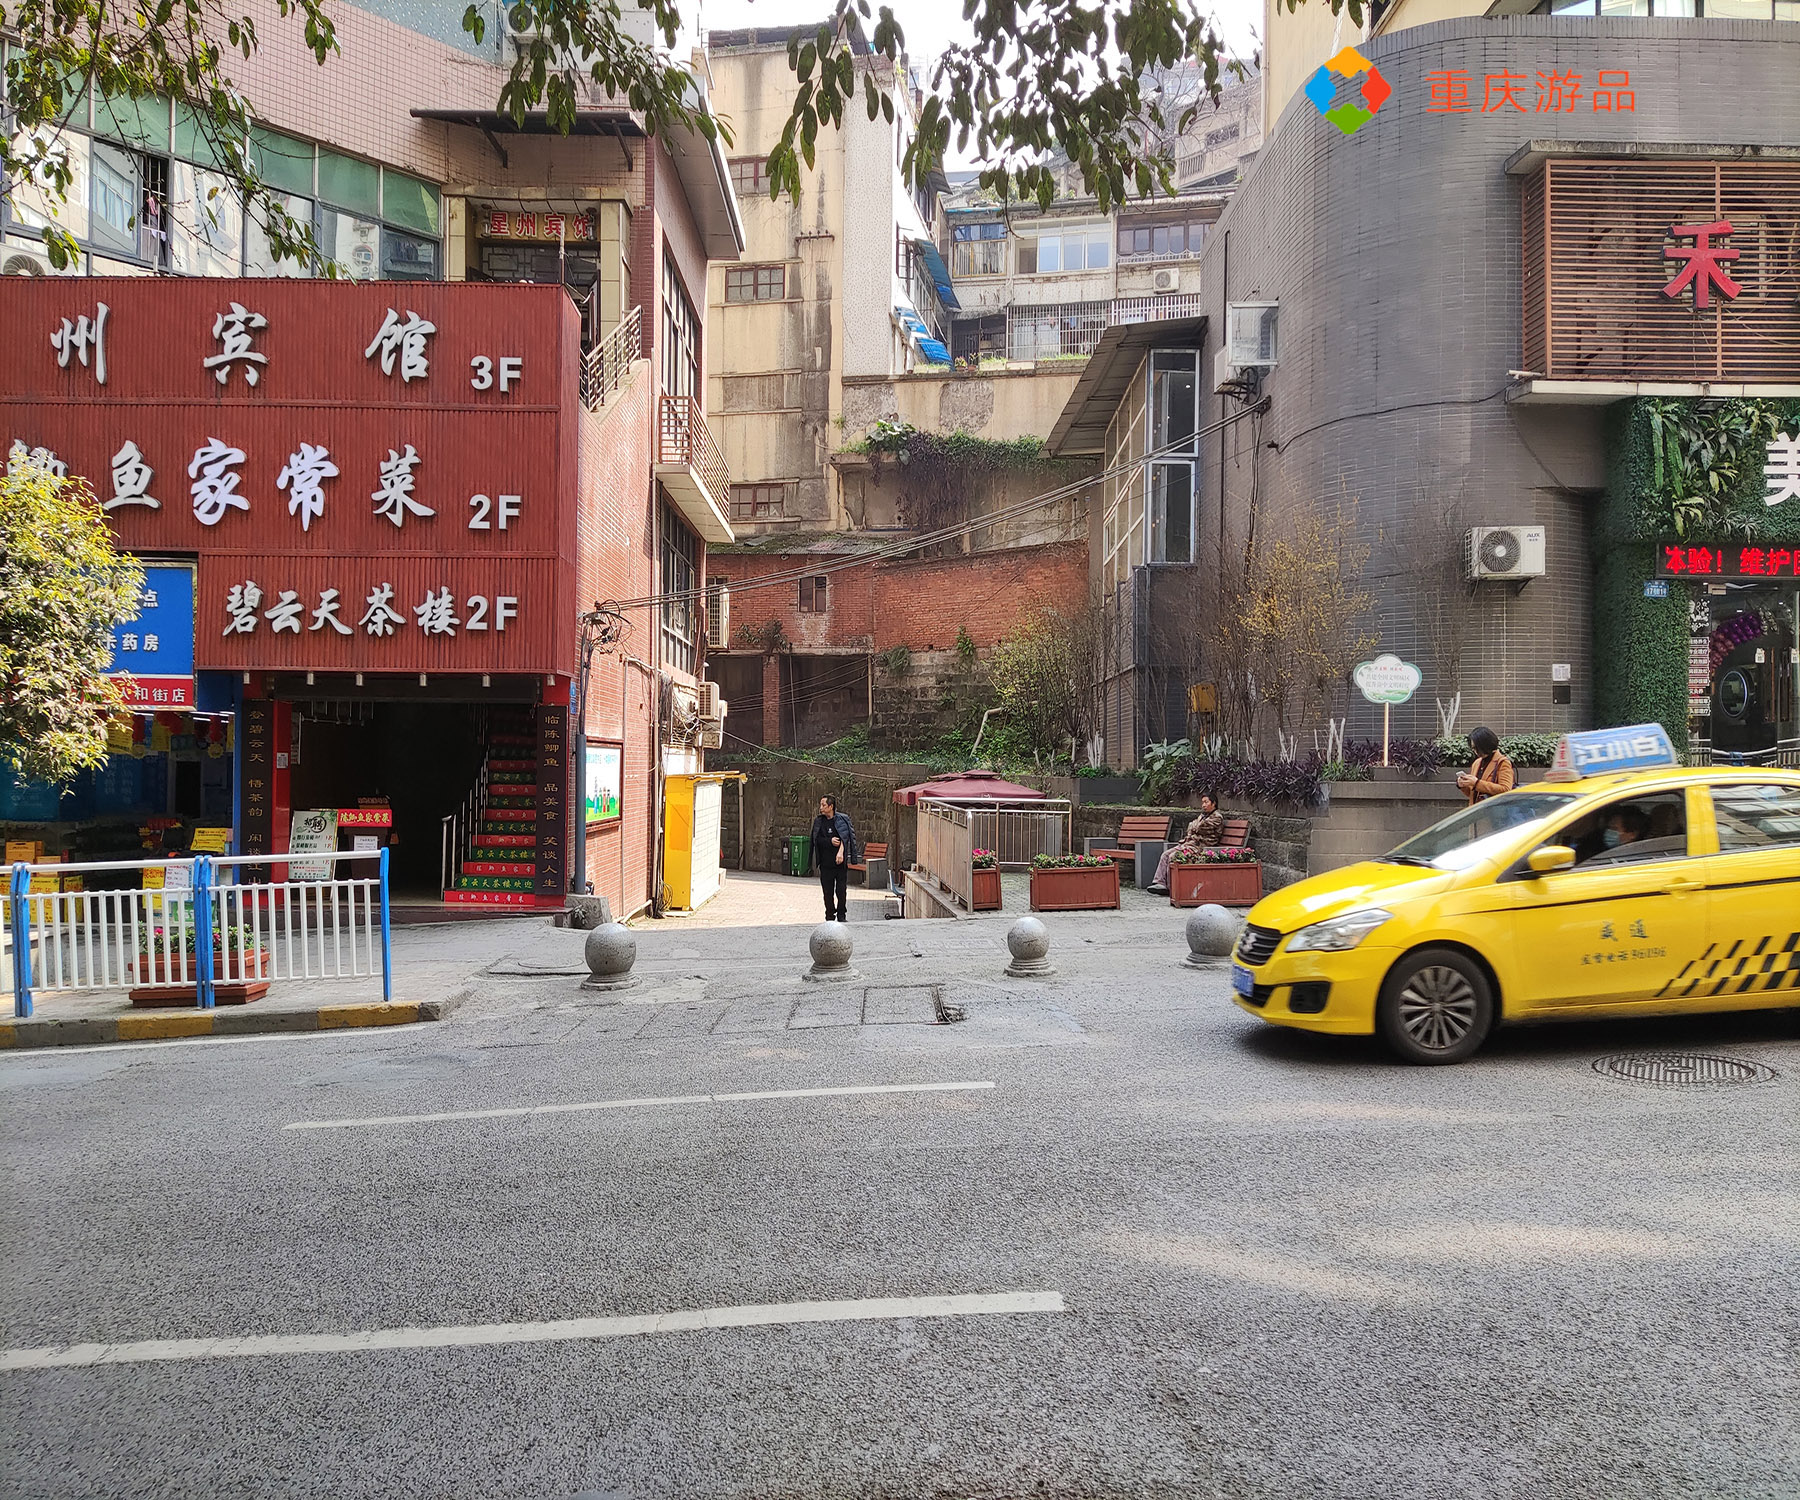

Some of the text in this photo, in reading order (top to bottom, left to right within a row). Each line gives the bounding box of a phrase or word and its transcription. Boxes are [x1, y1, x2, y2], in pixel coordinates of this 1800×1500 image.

[490, 211, 590, 239] 星州宾馆
[1658, 220, 1743, 311] 禾
[50, 302, 523, 394] 州宾馆 3F
[1763, 431, 1800, 507] 美
[469, 494, 522, 531] 2F
[543, 783, 559, 821] 品美食
[542, 836, 558, 888] 笑谈人生
